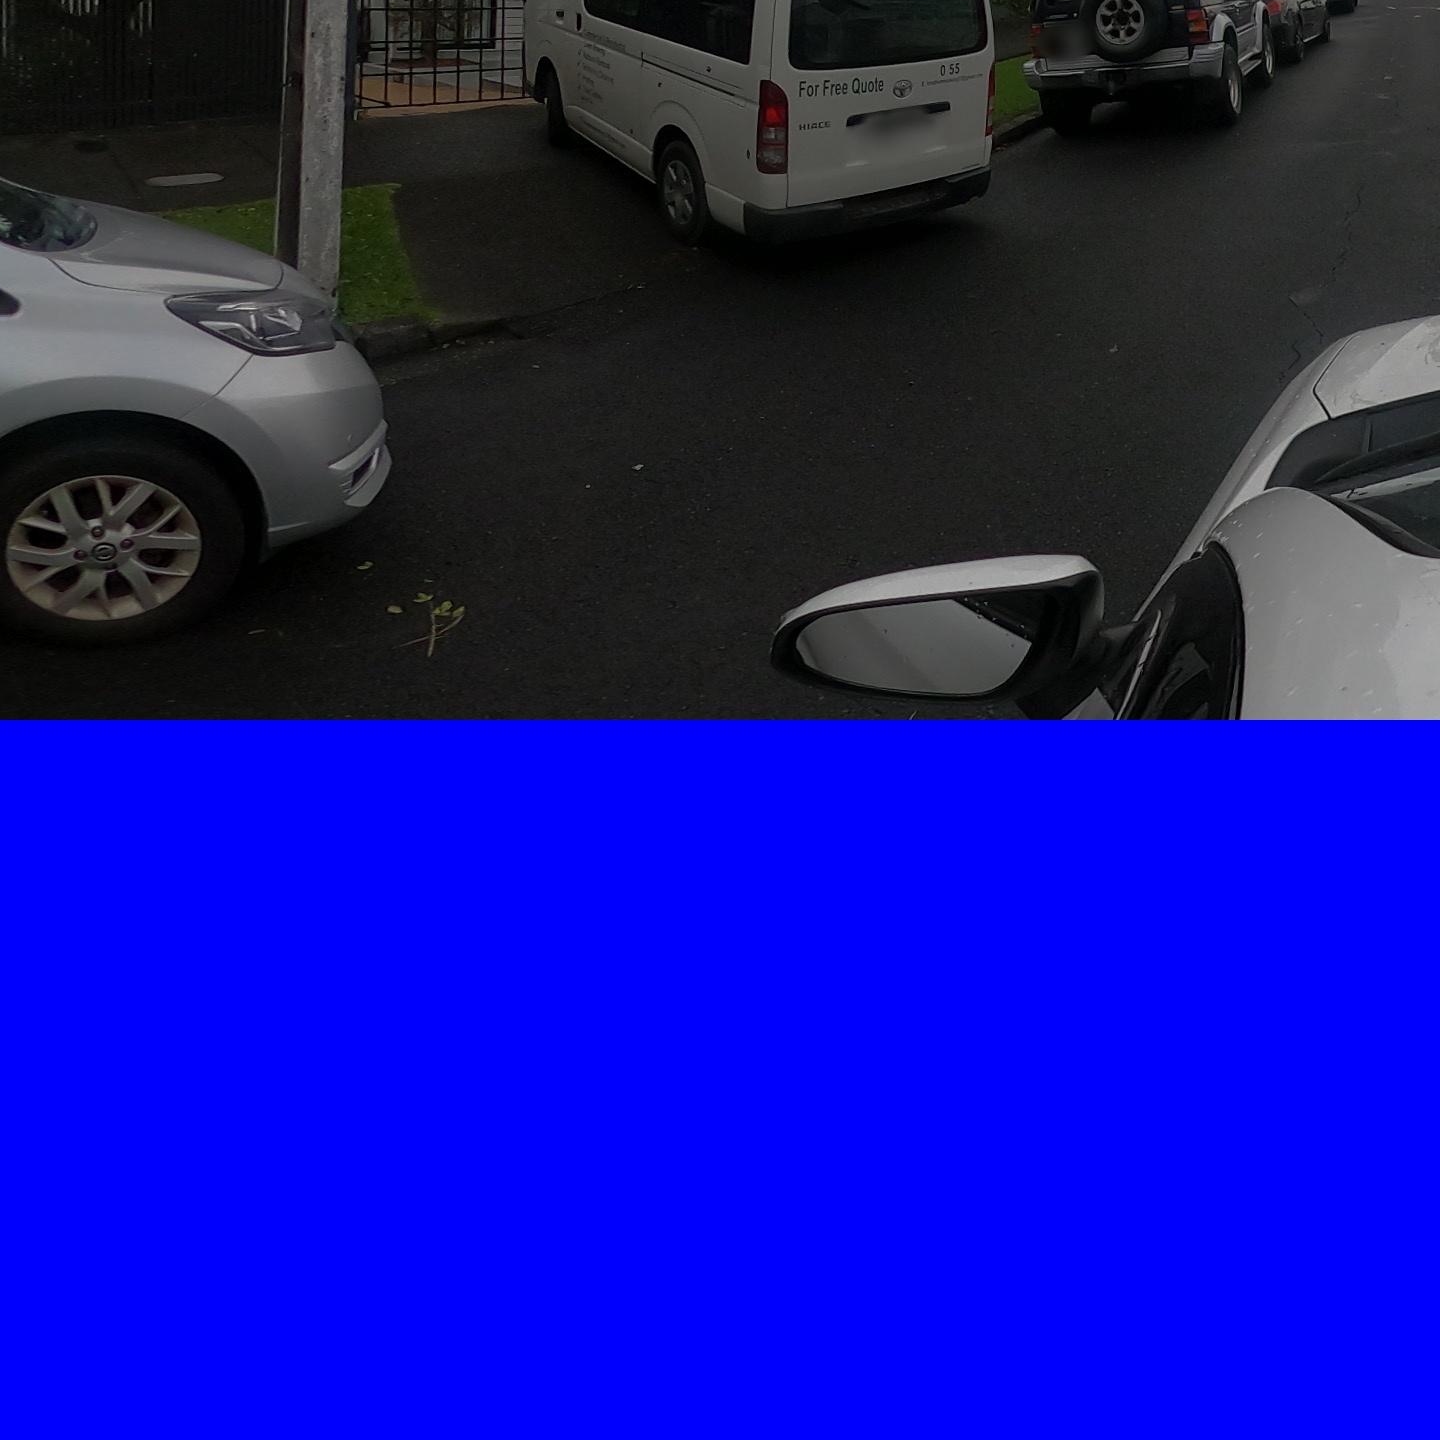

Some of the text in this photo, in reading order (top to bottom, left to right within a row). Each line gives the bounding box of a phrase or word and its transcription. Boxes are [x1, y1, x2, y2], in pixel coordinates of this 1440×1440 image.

[798, 76, 884, 97] For Free Quote
[799, 120, 832, 131] HIACE
